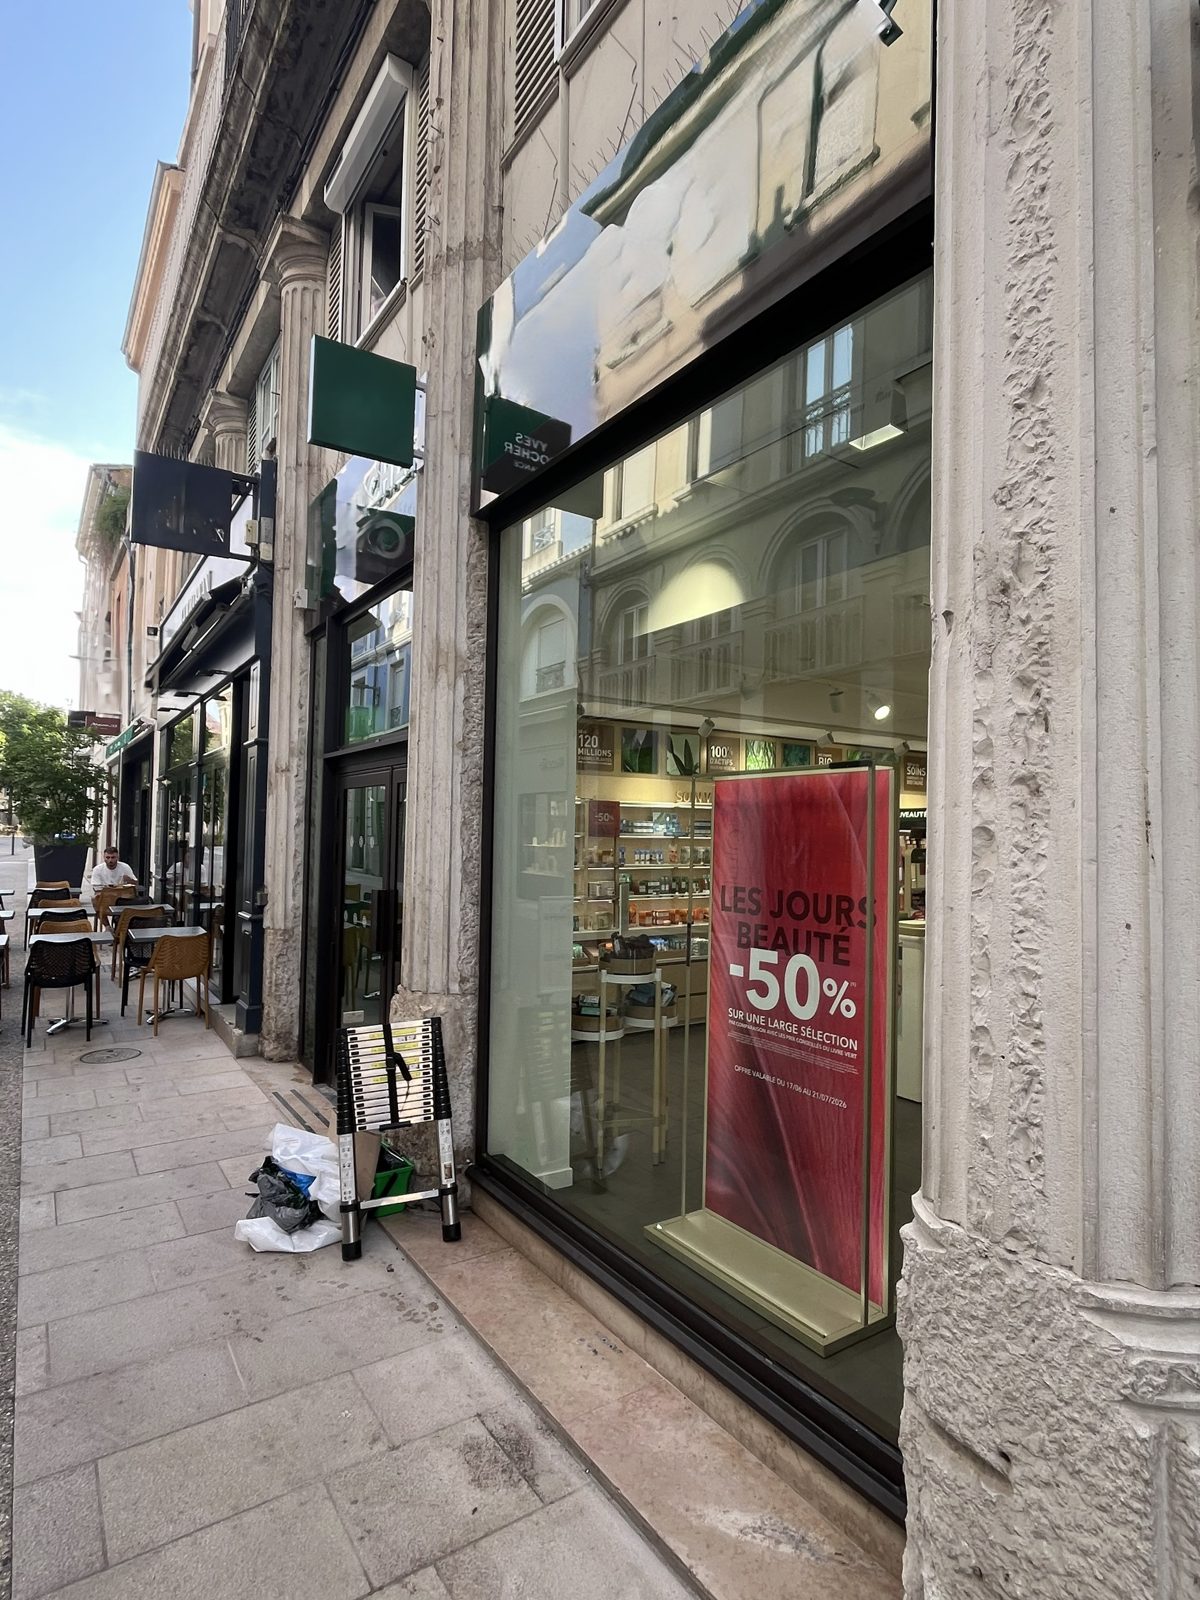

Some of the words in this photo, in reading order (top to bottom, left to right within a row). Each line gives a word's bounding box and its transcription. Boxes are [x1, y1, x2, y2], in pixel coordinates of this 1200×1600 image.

[577, 748, 612, 758] MILLIONS
[578, 734, 599, 748] 120
[906, 767, 926, 777] SOINS
[720, 885, 762, 916] LES
[769, 890, 877, 929] JOURS
[736, 921, 850, 966] BEAUTÉ
[729, 947, 857, 1020] -50%
[728, 1007, 744, 1020] SUR
[746, 1012, 766, 1026] UNE
[768, 1017, 799, 1035] LARGE
[800, 1025, 858, 1051] SÉLECTION
[734, 1064, 752, 1076] OFFRE
[752, 1070, 776, 1084] VALABLE
[776, 1078, 786, 1087] DU
[786, 1081, 802, 1093] 17/06
[802, 1087, 812, 1096] AU
